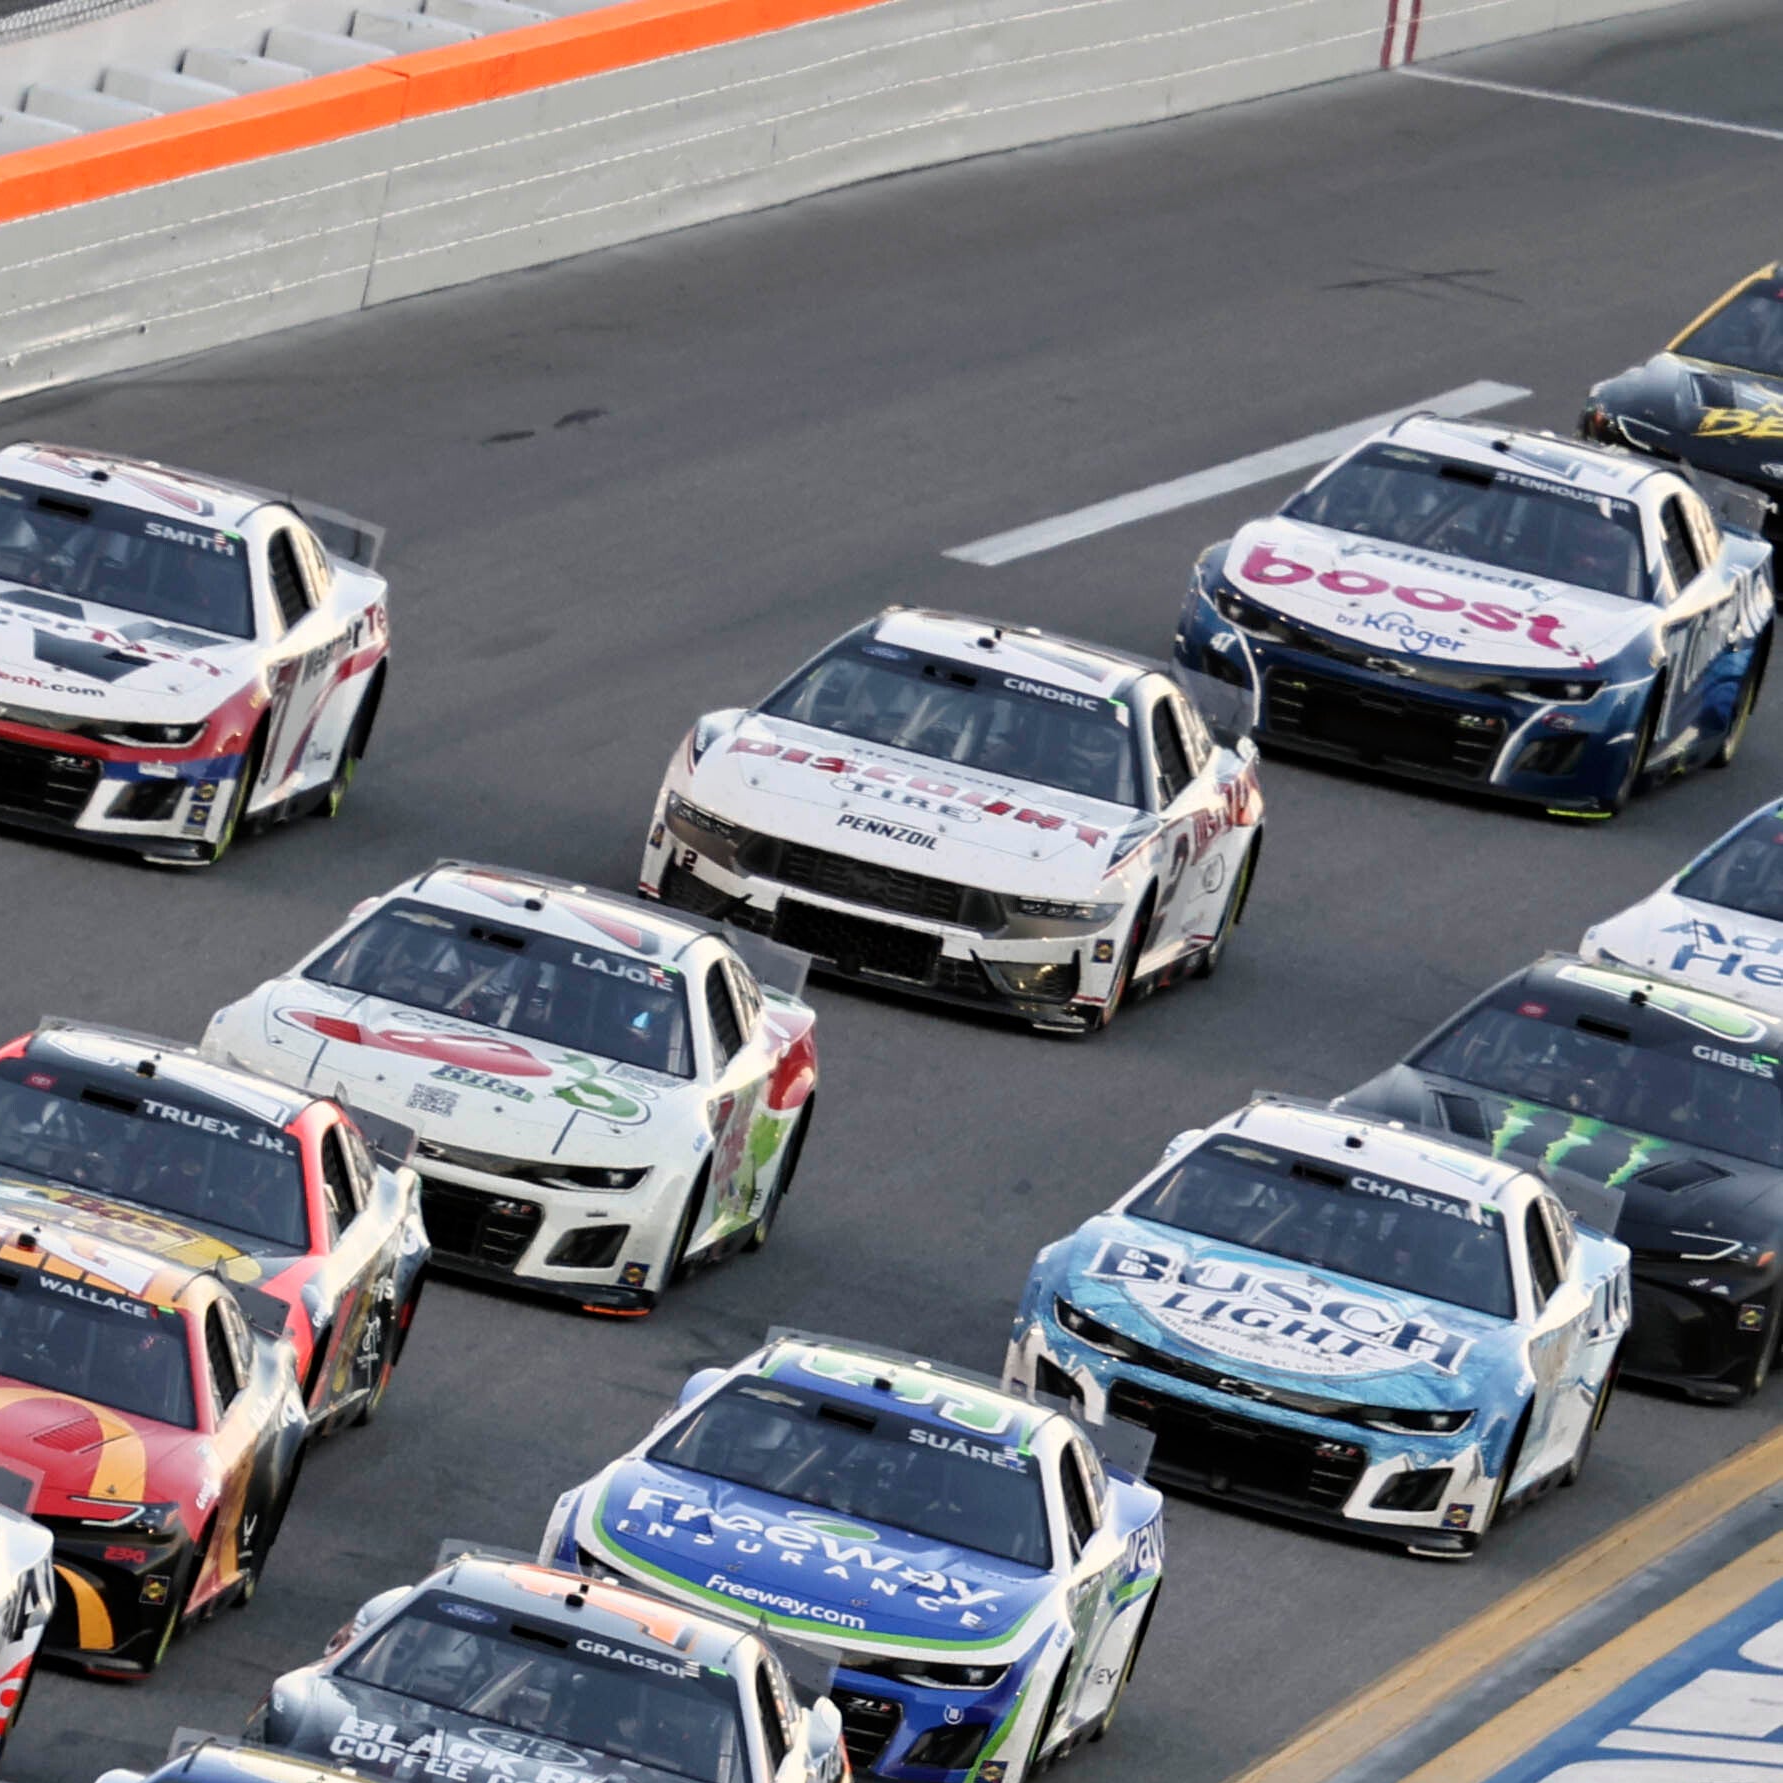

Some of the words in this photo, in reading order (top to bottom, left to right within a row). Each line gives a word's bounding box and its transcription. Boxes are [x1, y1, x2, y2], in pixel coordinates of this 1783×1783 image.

[1240, 544, 1581, 652] boost
[1362, 612, 1466, 656] Kroger
[1003, 677, 1099, 712] CINDRIC
[837, 813, 940, 851] PENNZOIL
[682, 849, 699, 872] 2
[143, 1097, 241, 1139] TRUEX
[1350, 1174, 1494, 1228] CHASTAN
[38, 1274, 149, 1319] WALLACE
[1083, 1239, 1478, 1377] BUSCH
[1160, 1291, 1372, 1362] LIGHT
[616, 1518, 987, 1629] INSURANCE
[705, 1573, 867, 1631] Freeway.com
[329, 1735, 468, 1783] COFFEE
[336, 1715, 517, 1774] BLACK
